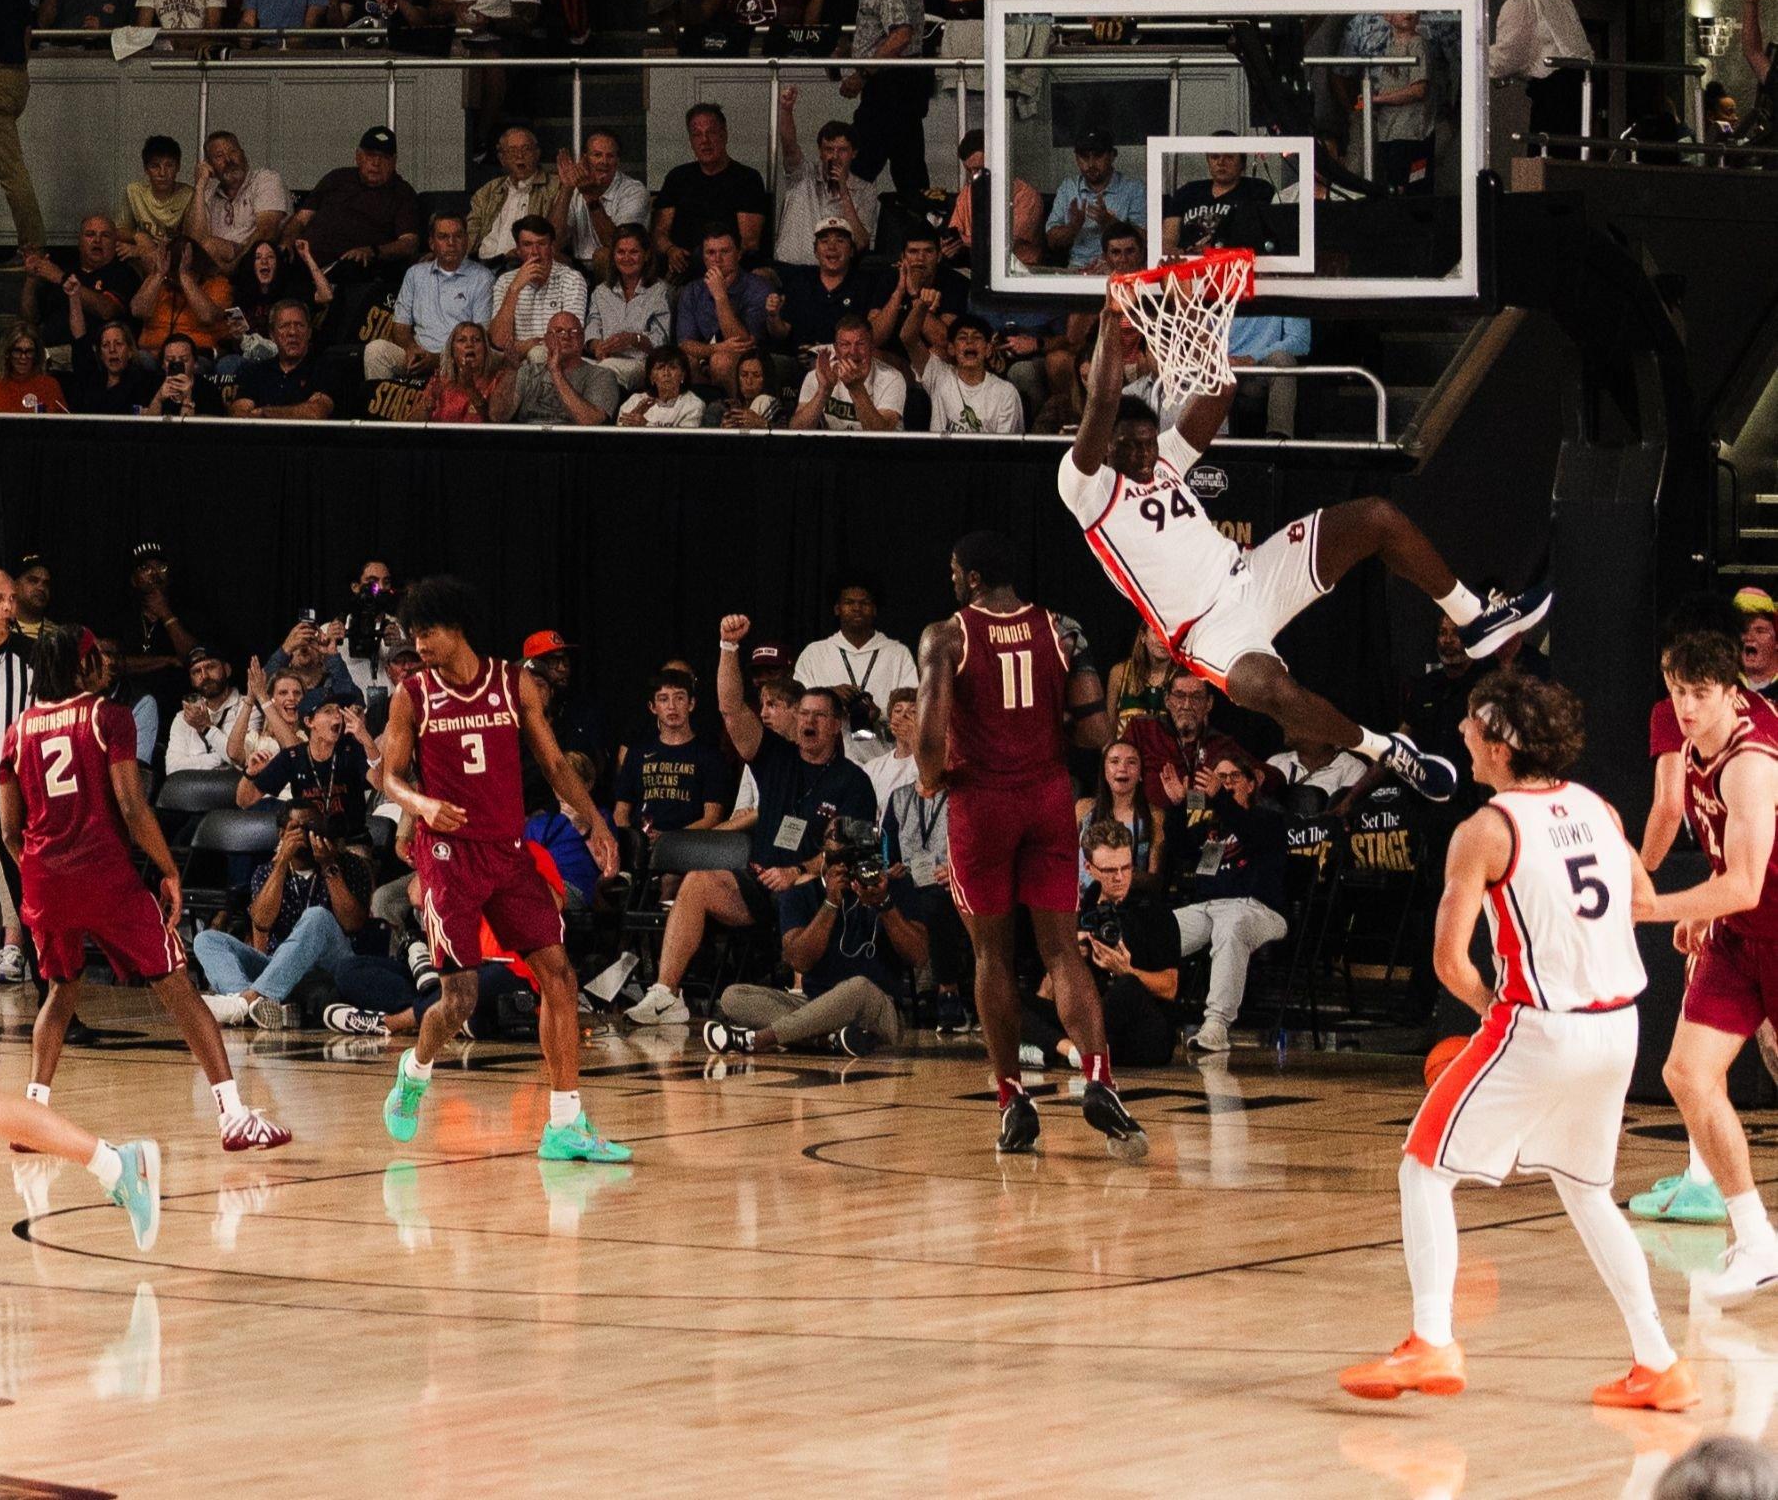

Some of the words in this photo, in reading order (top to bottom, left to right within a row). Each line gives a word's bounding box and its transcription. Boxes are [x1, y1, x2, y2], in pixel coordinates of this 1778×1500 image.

[1139, 488, 1197, 533] 94
[988, 622, 1032, 644] PONDER
[997, 650, 1034, 710] 11
[25, 710, 76, 735] ROBINSON
[430, 712, 512, 733] SEMINOLES
[461, 733, 486, 774] 3
[41, 736, 78, 798] 2
[643, 763, 658, 774] NEW
[659, 762, 695, 775] ORLEANS
[643, 775, 679, 786] PELICANS
[1361, 813, 1379, 829] Set
[1379, 811, 1400, 827] The
[1287, 828, 1308, 846] Set
[1308, 825, 1329, 843] The
[1548, 822, 1594, 849] DOWD
[1351, 829, 1415, 873] STAGE
[1565, 855, 1609, 920] 5
